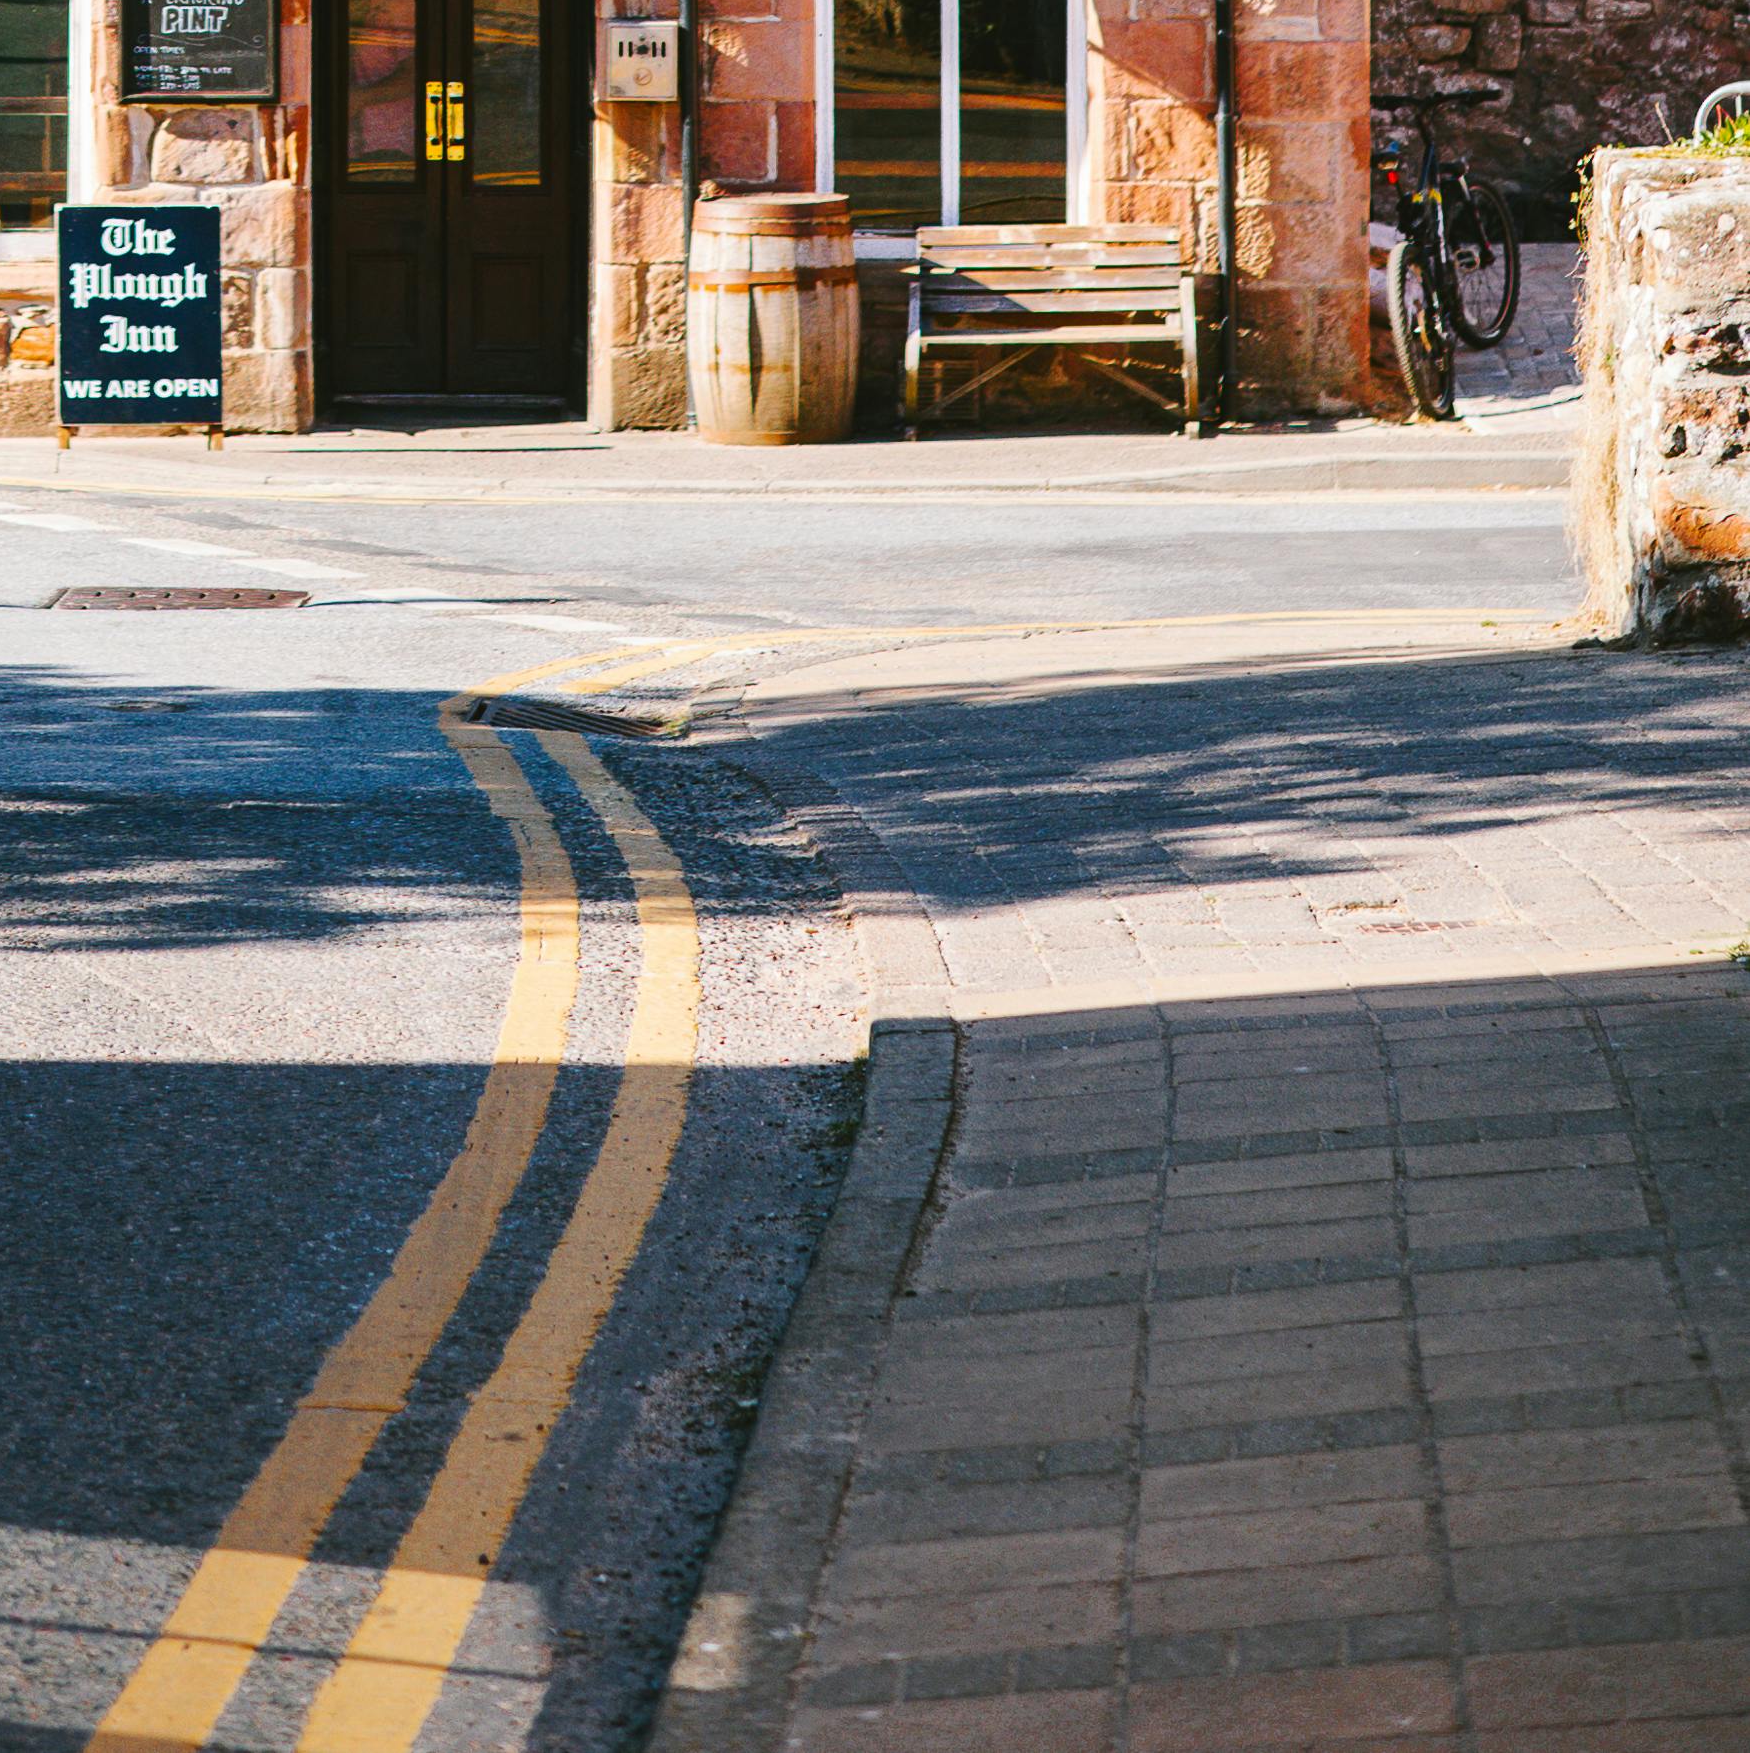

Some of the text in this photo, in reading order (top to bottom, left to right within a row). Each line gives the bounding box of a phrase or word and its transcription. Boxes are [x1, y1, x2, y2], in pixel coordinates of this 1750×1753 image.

[161, 5, 228, 33] PINT
[101, 218, 176, 256] The
[69, 262, 208, 308] Plough
[100, 315, 179, 353] Inn
[63, 379, 219, 398] WE ARE OPEN
